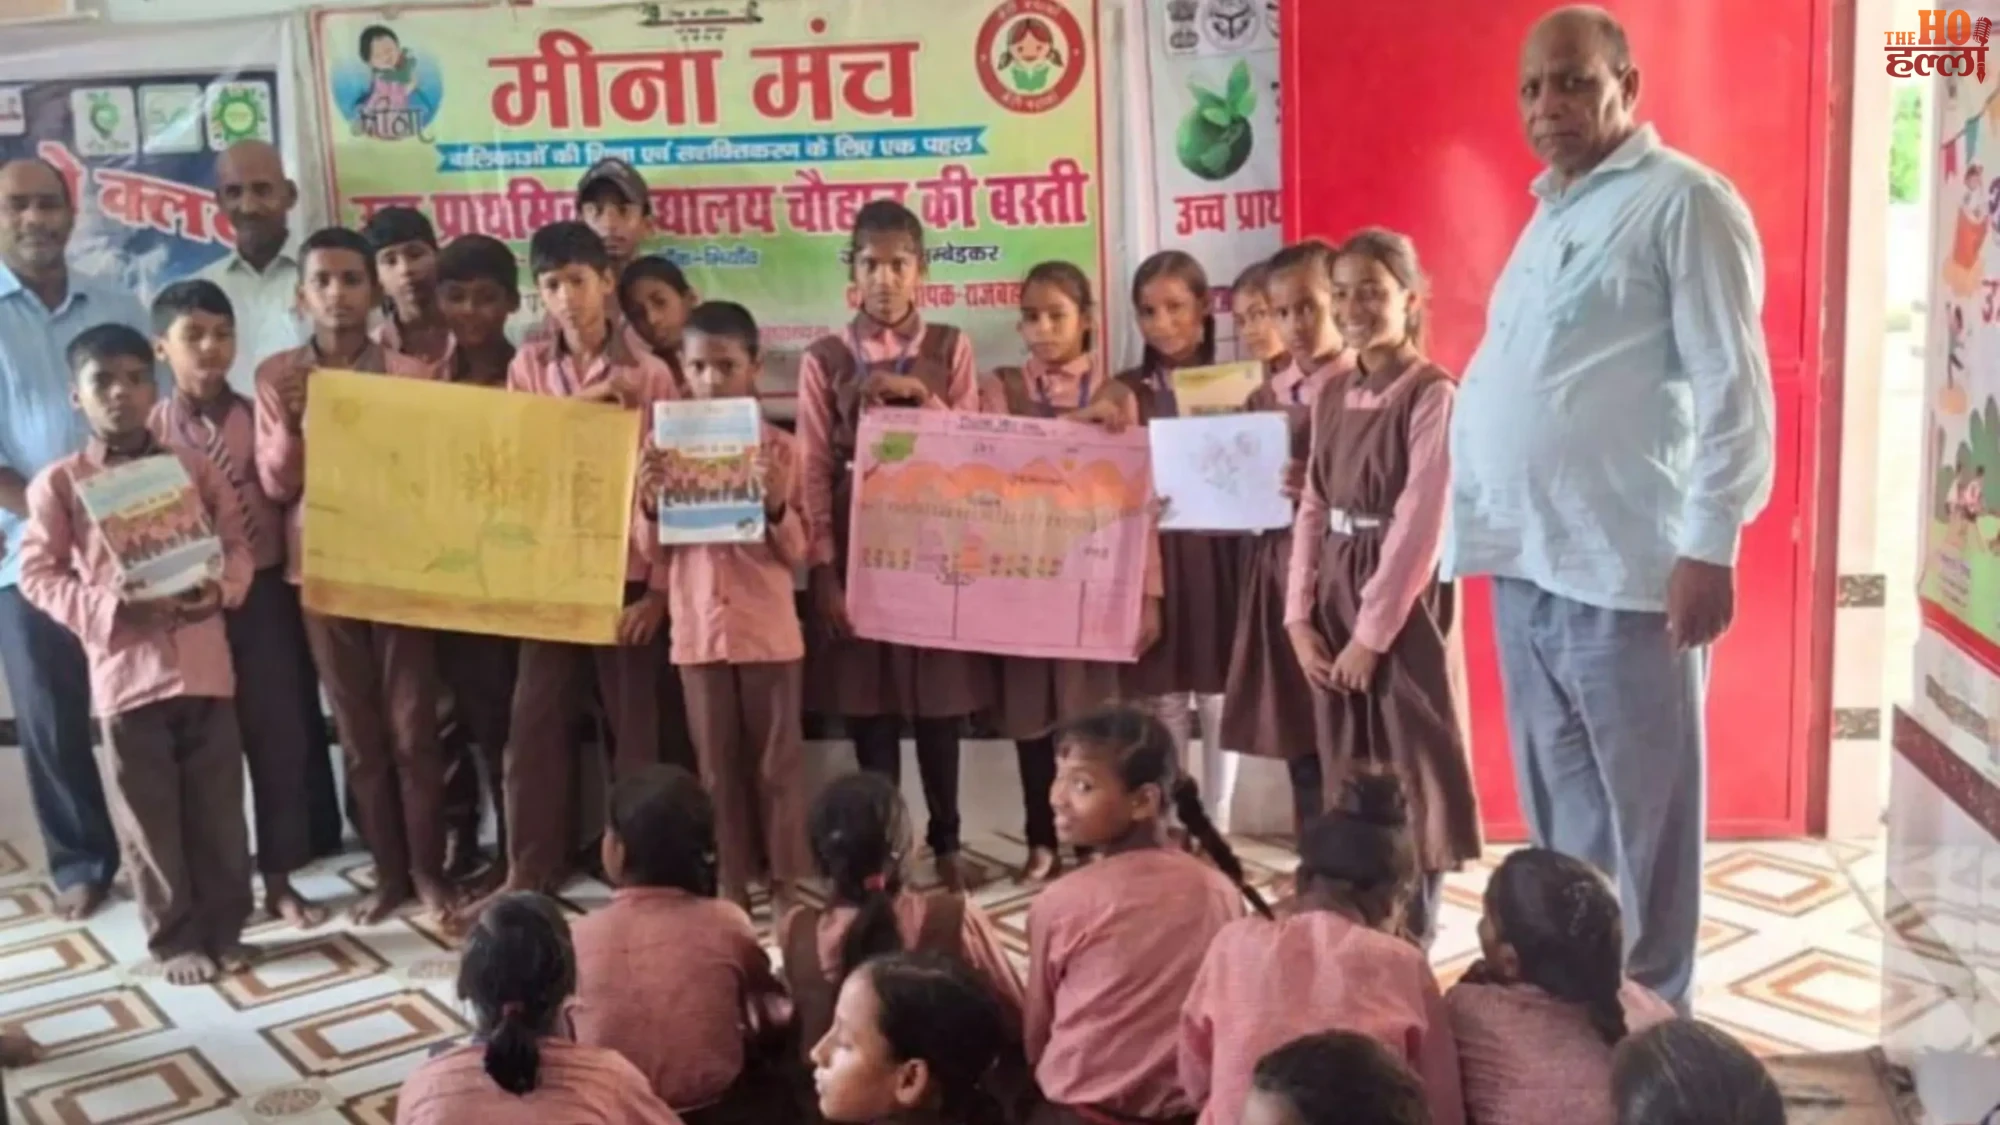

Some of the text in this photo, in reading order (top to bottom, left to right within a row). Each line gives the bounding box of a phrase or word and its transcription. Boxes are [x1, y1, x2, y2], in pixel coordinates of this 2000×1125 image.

[488, 18, 920, 129] मीना मंच
[917, 165, 978, 229] की
[984, 159, 1089, 226] बस्ती
